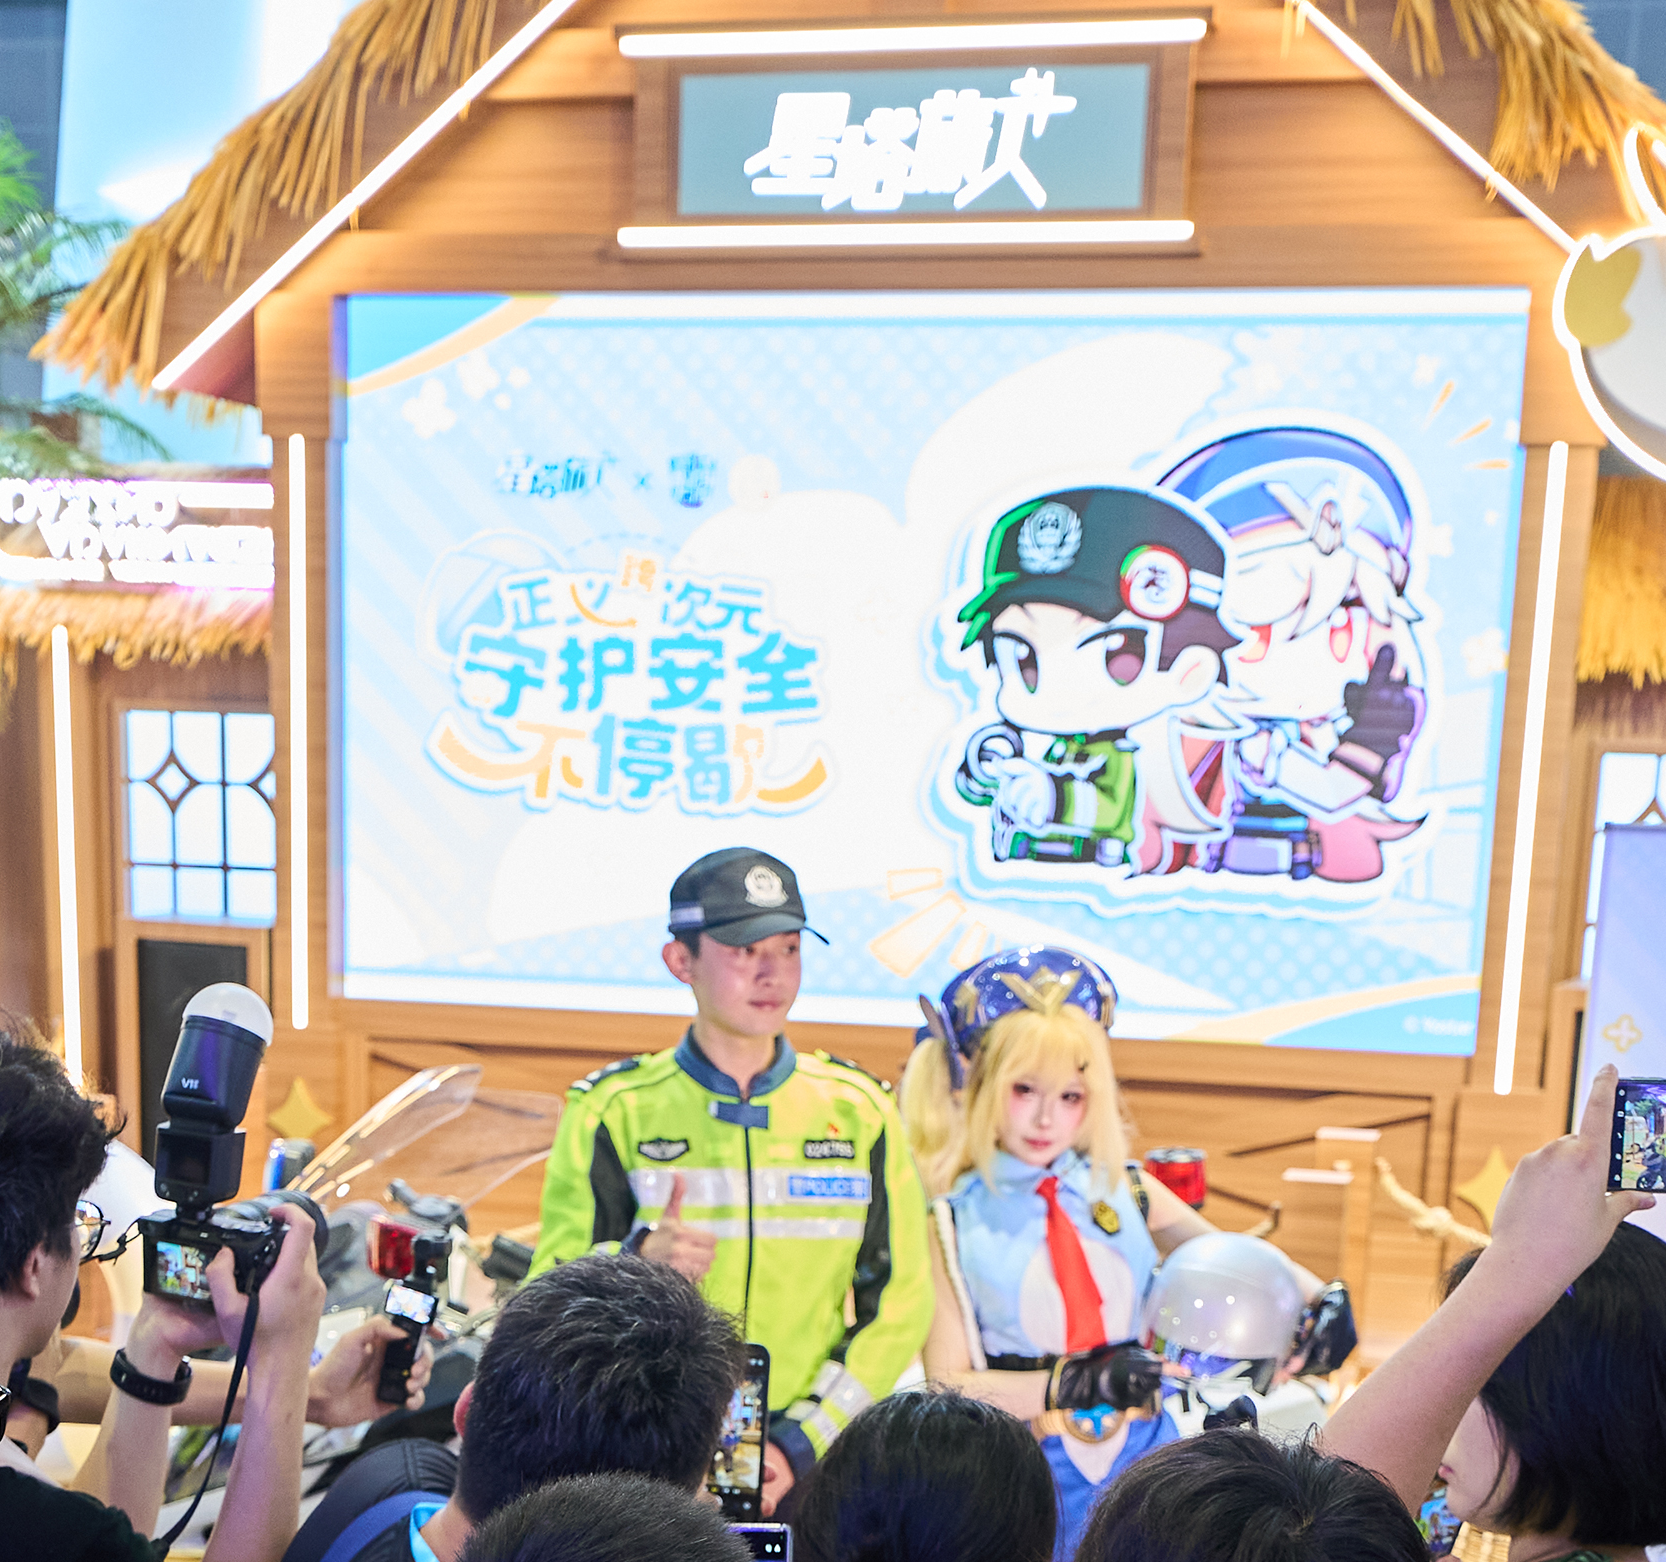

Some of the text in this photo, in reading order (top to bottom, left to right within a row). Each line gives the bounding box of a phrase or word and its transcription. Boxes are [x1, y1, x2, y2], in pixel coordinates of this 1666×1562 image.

[463, 631, 820, 718] 守护安全
[437, 713, 828, 806] 不停歇
